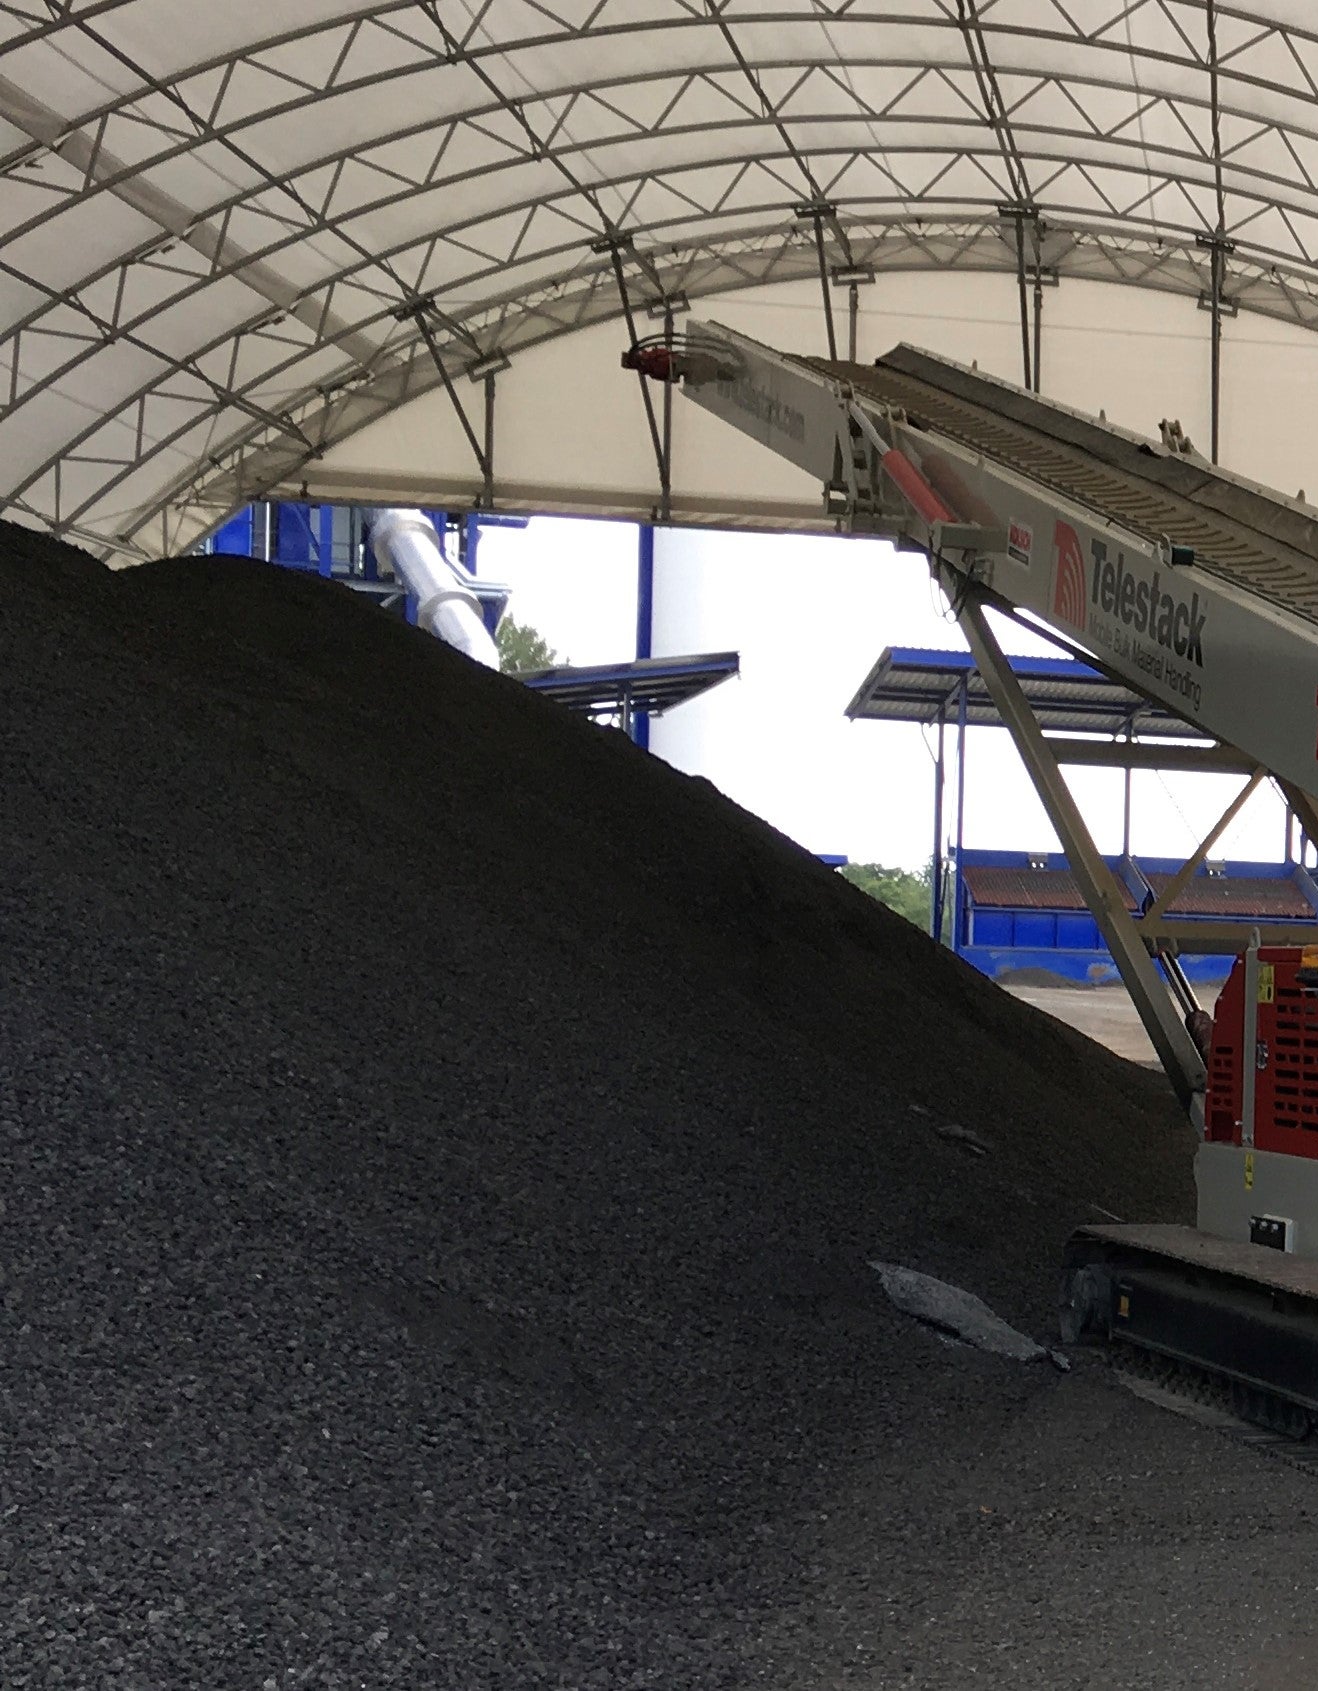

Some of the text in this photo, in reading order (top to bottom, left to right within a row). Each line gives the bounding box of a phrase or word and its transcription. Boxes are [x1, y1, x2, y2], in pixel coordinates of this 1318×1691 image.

[1090, 538, 1208, 668] Telestack
[1113, 627, 1132, 662] Bulk
[1132, 637, 1165, 681] Material
[1165, 656, 1202, 712] Handling
